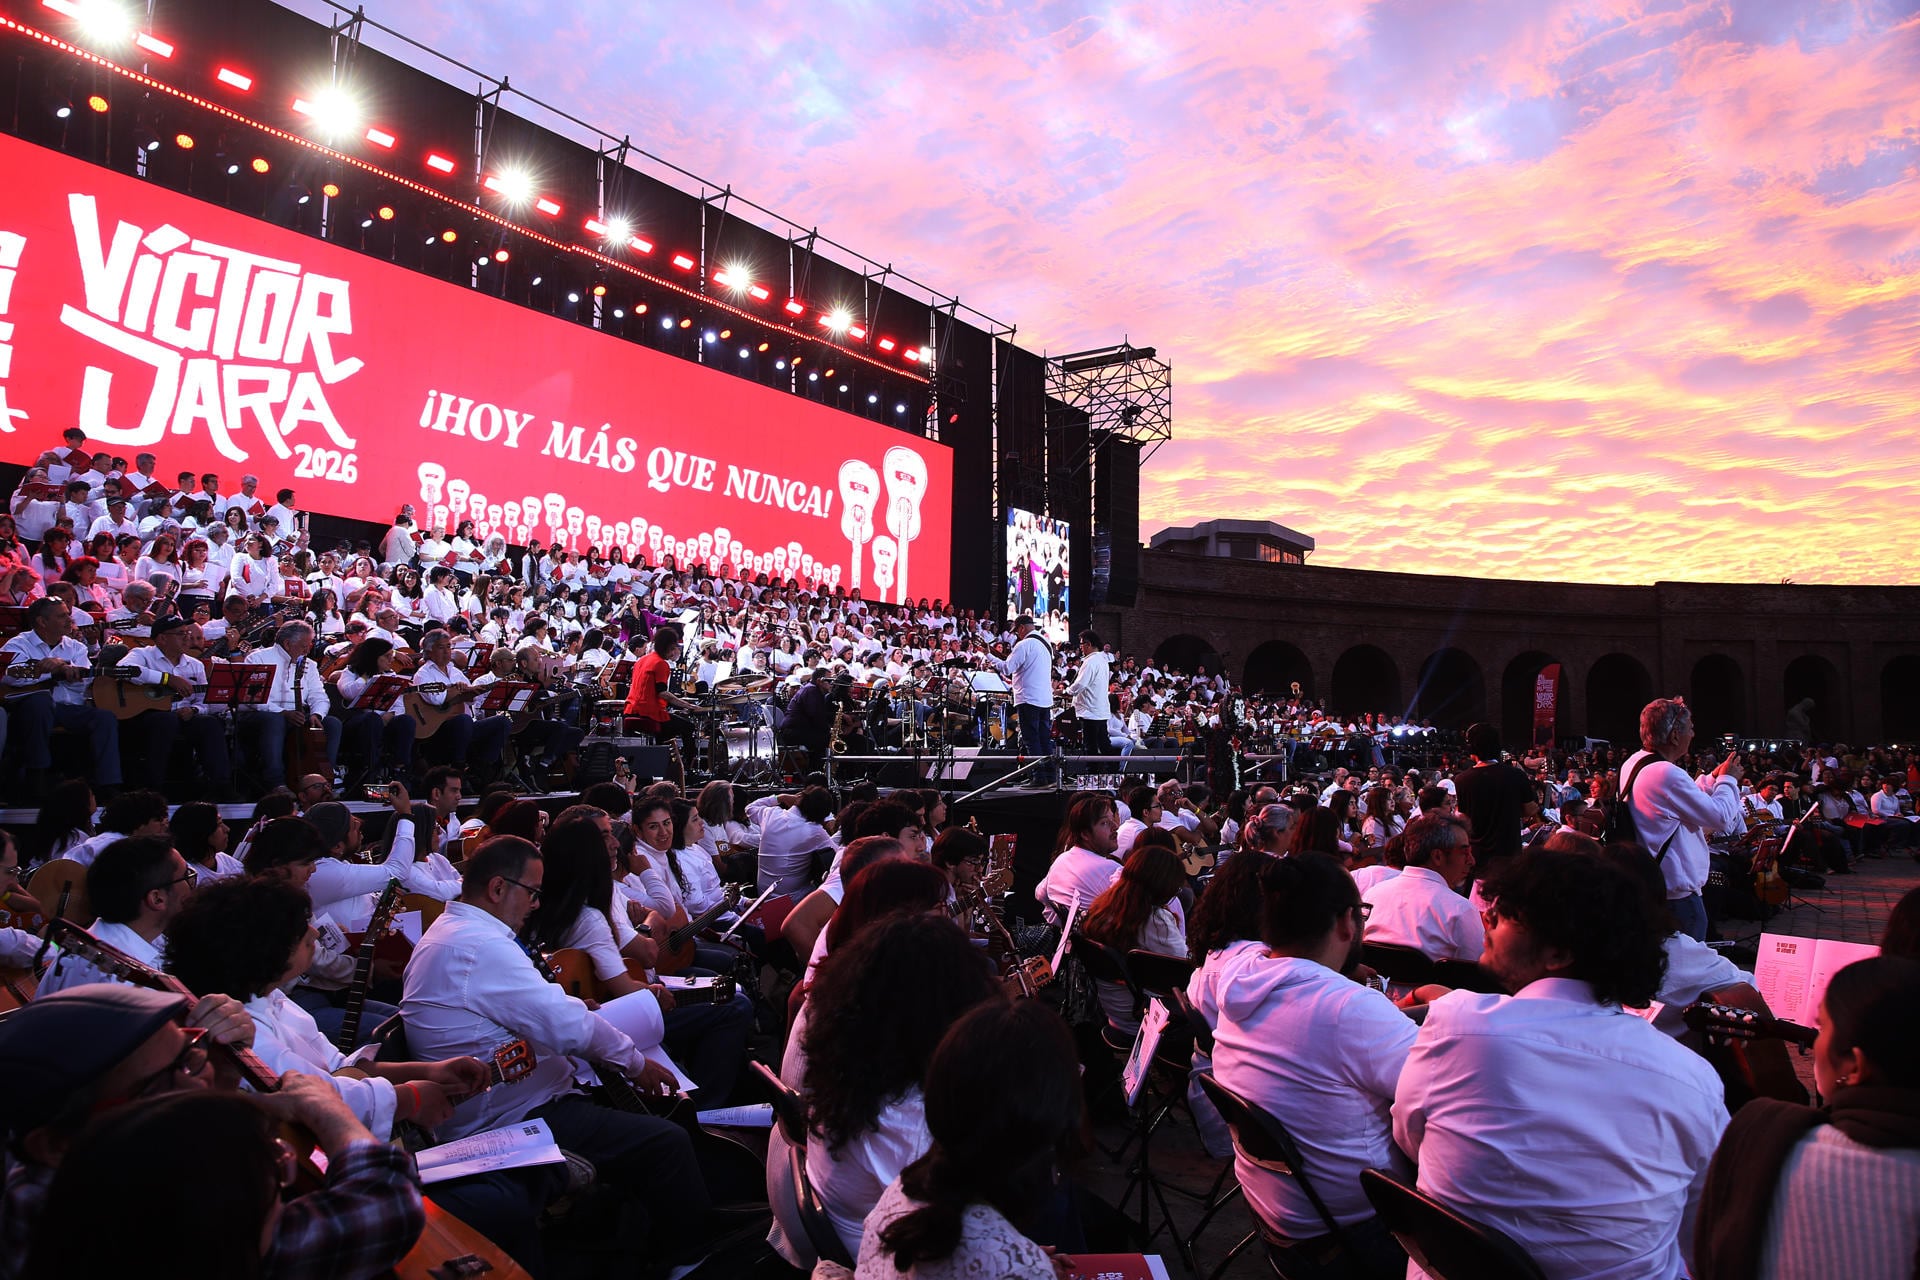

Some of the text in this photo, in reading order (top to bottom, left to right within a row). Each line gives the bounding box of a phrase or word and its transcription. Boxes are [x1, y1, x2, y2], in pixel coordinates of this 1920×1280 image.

[67, 193, 365, 385] VÍCTOR
[59, 303, 357, 463] JARA
[419, 389, 834, 519] ¡HOY MÁS QUE NUNCA!
[293, 443, 358, 484] 2026
